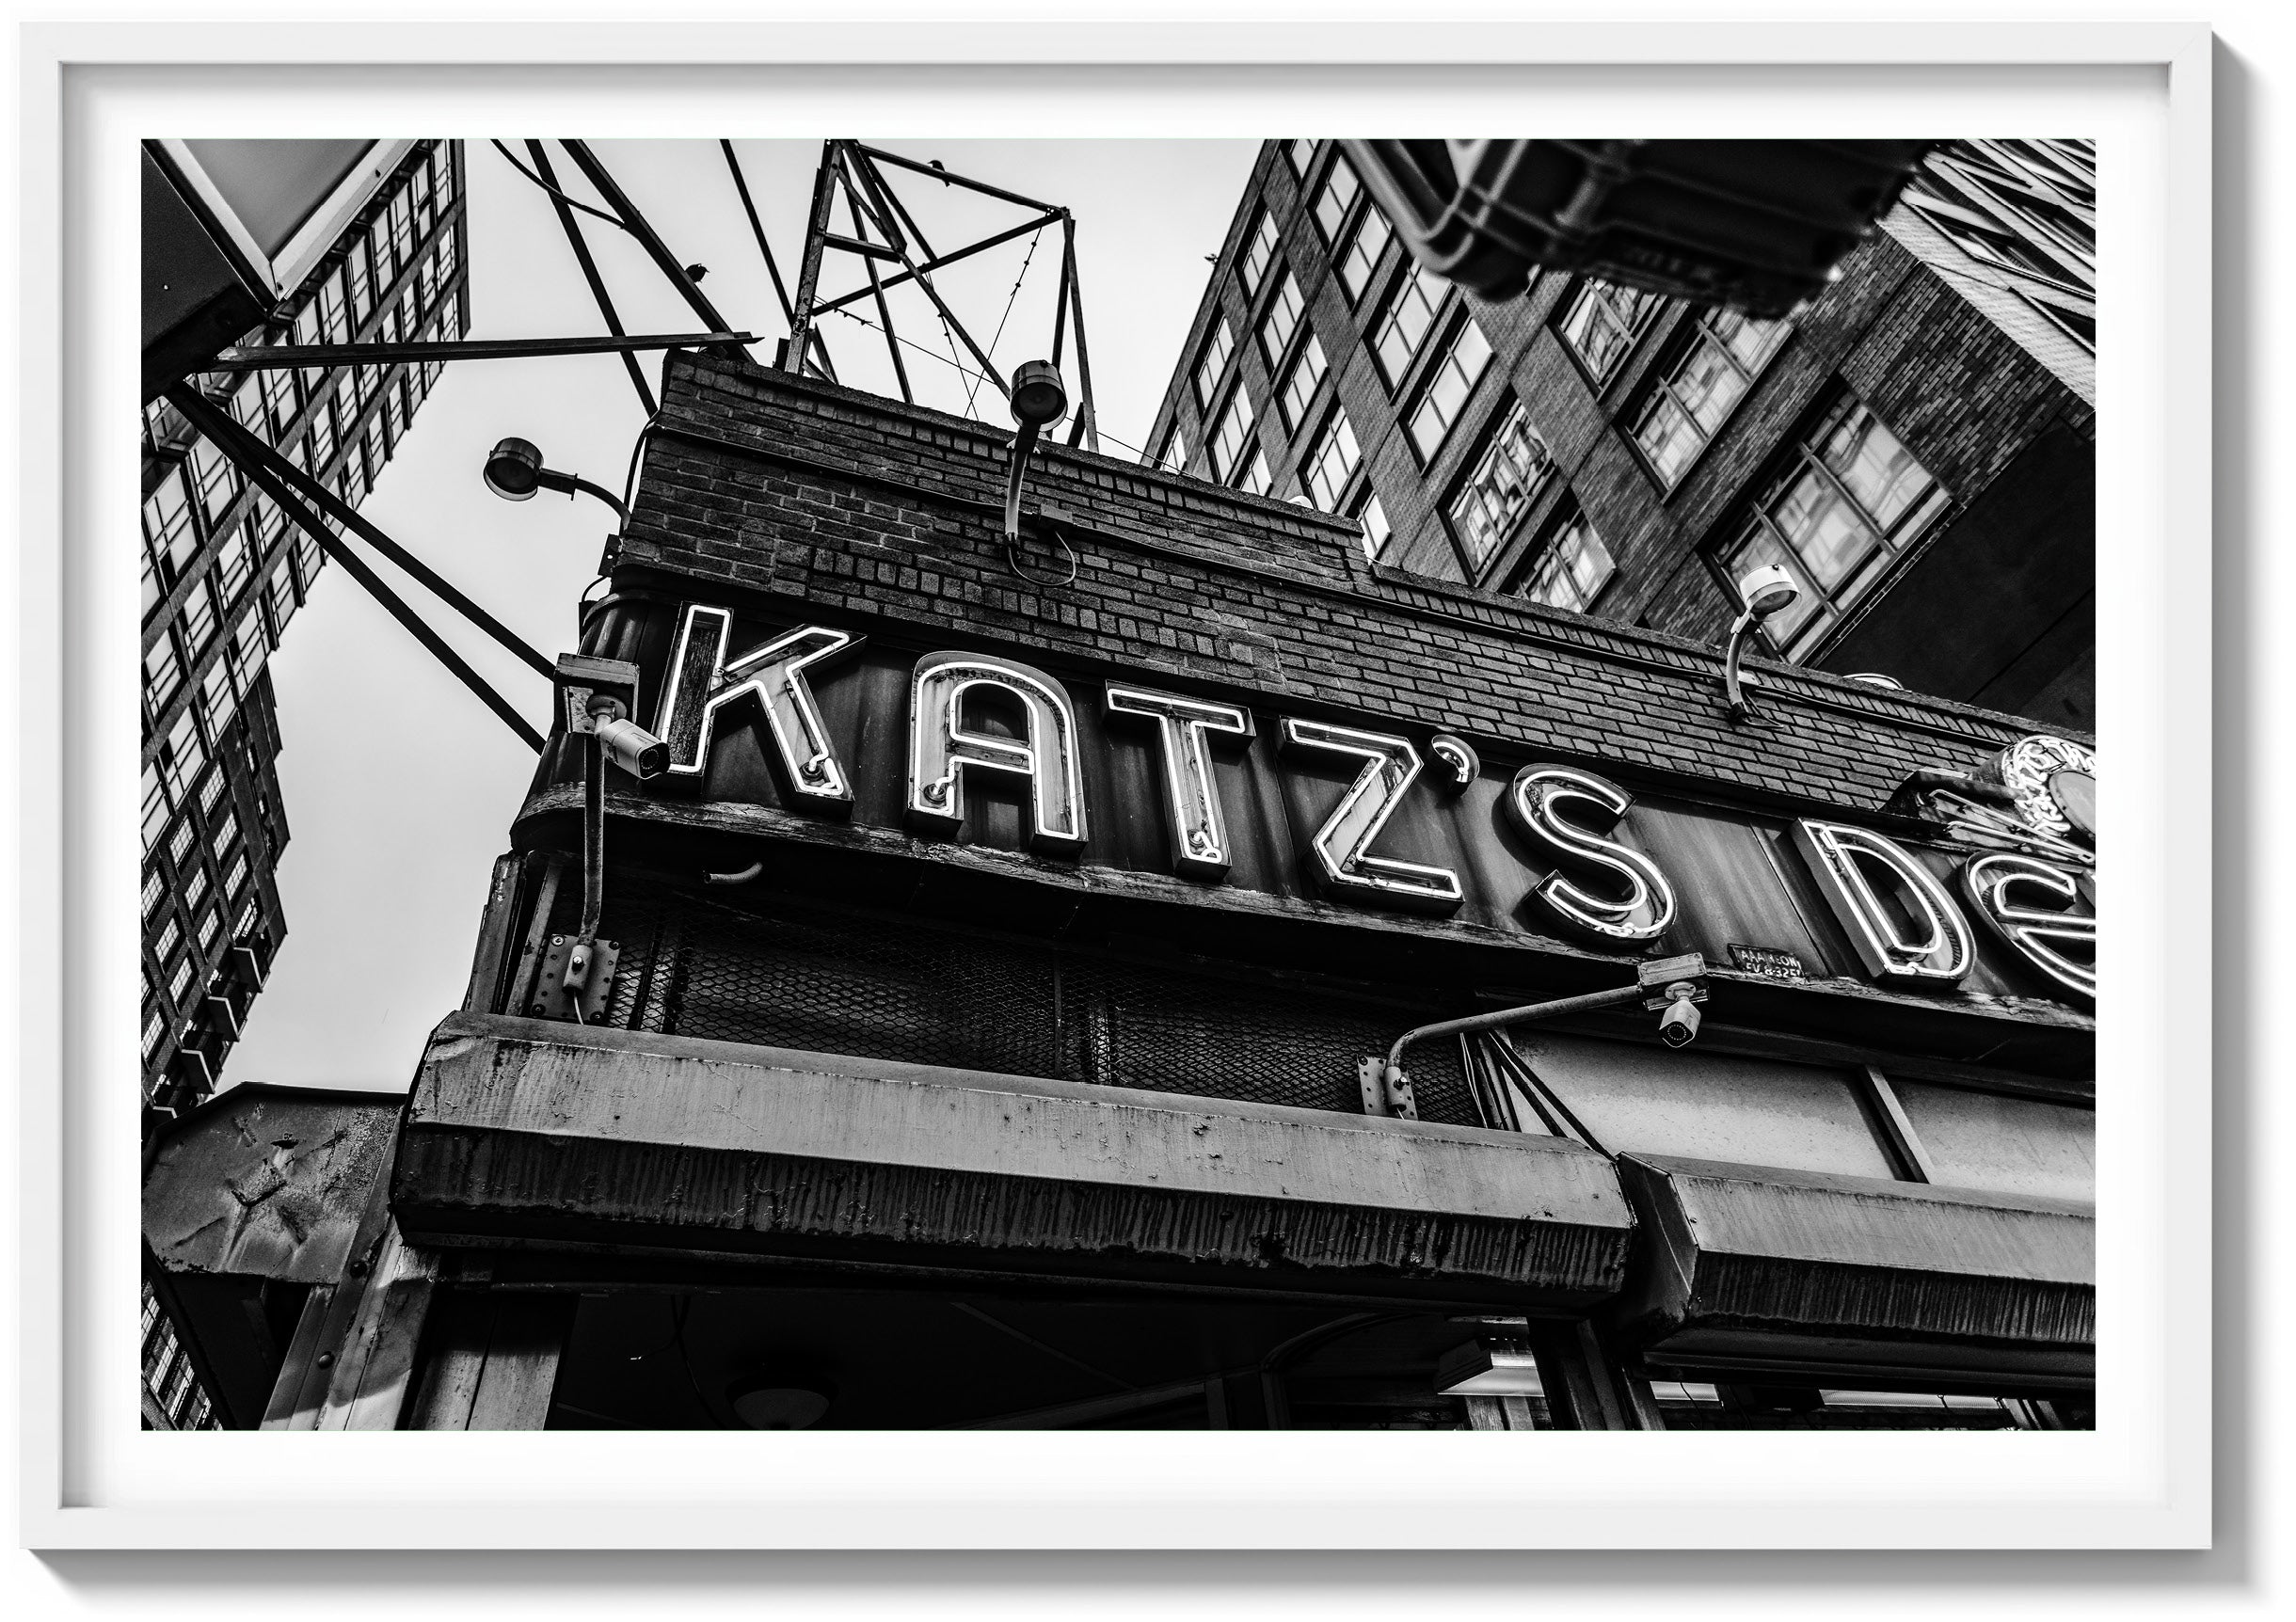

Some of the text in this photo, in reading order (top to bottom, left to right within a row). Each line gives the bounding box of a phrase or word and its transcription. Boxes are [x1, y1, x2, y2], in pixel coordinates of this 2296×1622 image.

[650, 600, 2096, 1001] KATZ'S De
[1741, 949, 1766, 963] AAA
